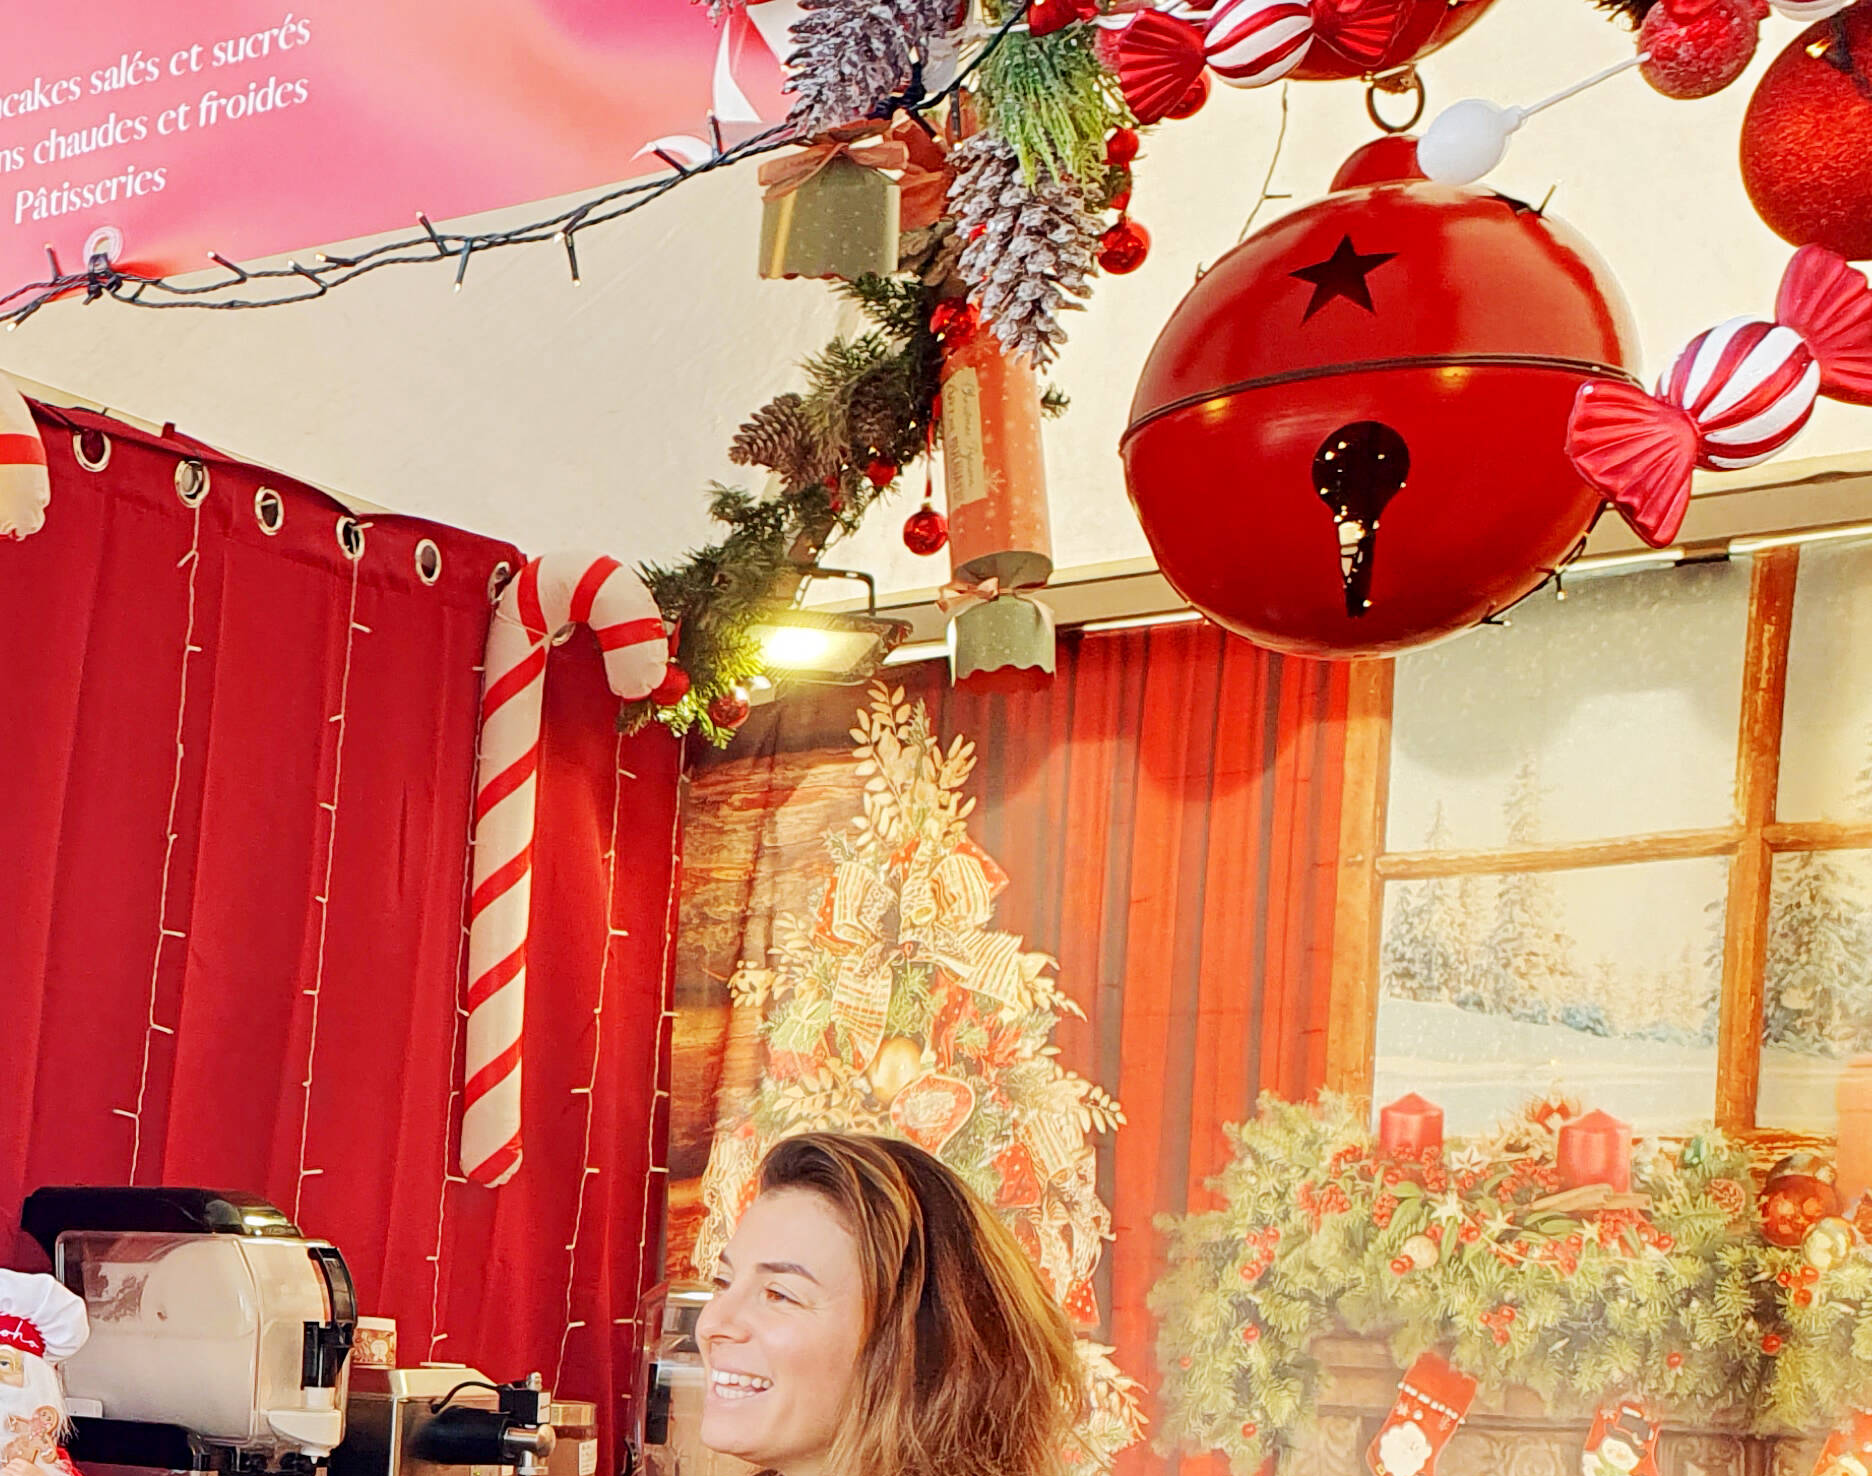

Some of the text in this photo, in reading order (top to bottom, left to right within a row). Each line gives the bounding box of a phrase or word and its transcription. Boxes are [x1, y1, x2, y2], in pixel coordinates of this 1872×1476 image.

[89, 49, 160, 96] salés
[169, 41, 204, 75] et
[211, 14, 311, 68] sucrés
[32, 109, 147, 166] chaudes
[157, 101, 192, 136] et
[199, 74, 309, 128] froides
[14, 163, 167, 225] Pâtisseries
